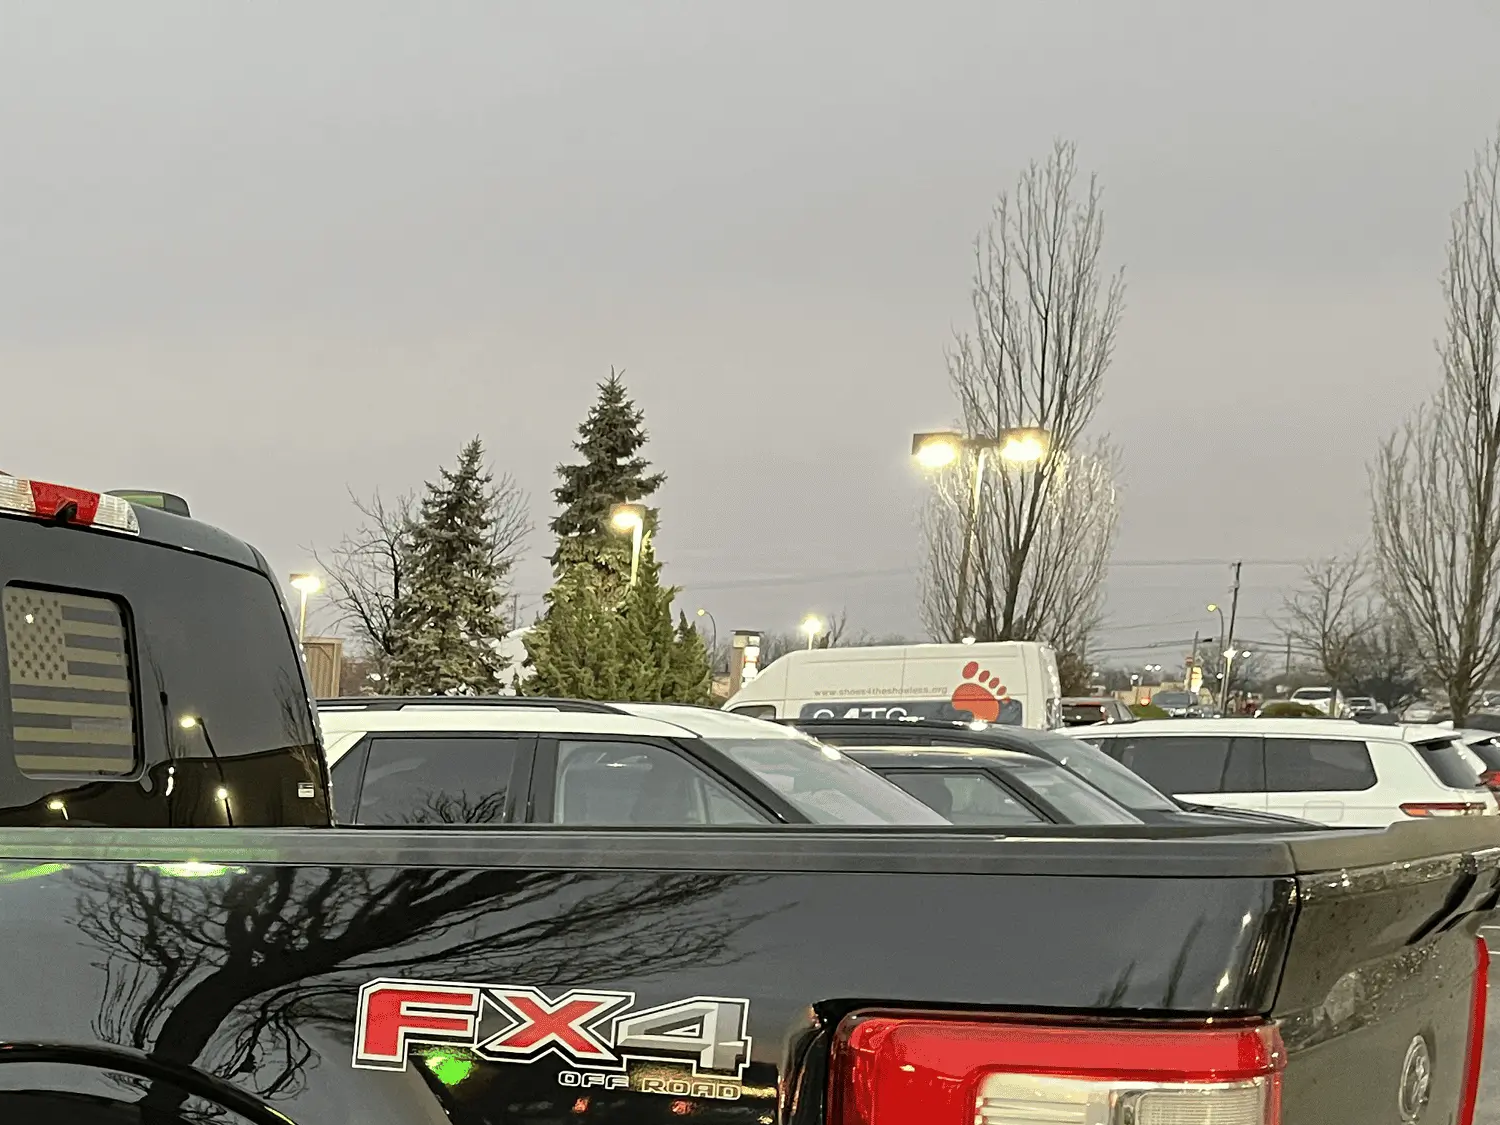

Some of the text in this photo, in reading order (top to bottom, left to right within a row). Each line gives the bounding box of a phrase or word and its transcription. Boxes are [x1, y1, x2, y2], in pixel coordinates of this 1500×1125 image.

[352, 978, 752, 1079] FX4
[558, 1071, 741, 1100] OFF ROAD
